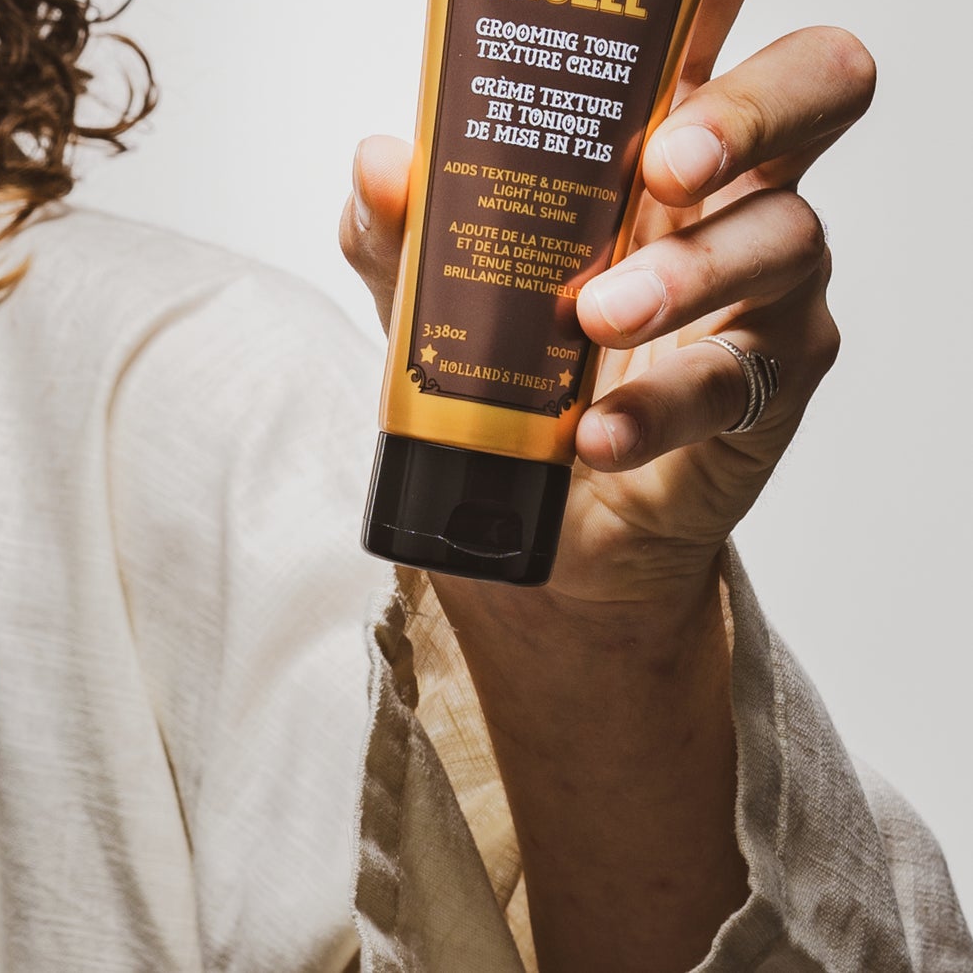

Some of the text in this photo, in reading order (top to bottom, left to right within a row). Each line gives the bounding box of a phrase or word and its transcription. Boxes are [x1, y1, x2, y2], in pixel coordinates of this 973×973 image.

[476, 17, 640, 63] GROOMING TONIC
[476, 39, 632, 84] TEXTURE CREAM
[471, 76, 624, 120] CRÈME TEXTURE
[486, 100, 601, 138] EN TONIQUE
[464, 119, 614, 163] DE MISE EN PLIS
[443, 161, 618, 202] ADDS TEXTURE & DEFINITION
[493, 183, 568, 207] LIGHT HOLD
[477, 195, 578, 224] NATURAL SHINE
[449, 221, 593, 257] AJOUTE DE LA TEXTURE
[456, 237, 582, 270] ET DE LA DÉFINITION
[443, 264, 513, 287] BRILLANCE
[471, 254, 564, 281] TENUE SOUPLE
[422, 323, 468, 341] 3.38oz
[546, 345, 581, 361] 100ml
[439, 359, 556, 392] HOLLAND'S FINEST
